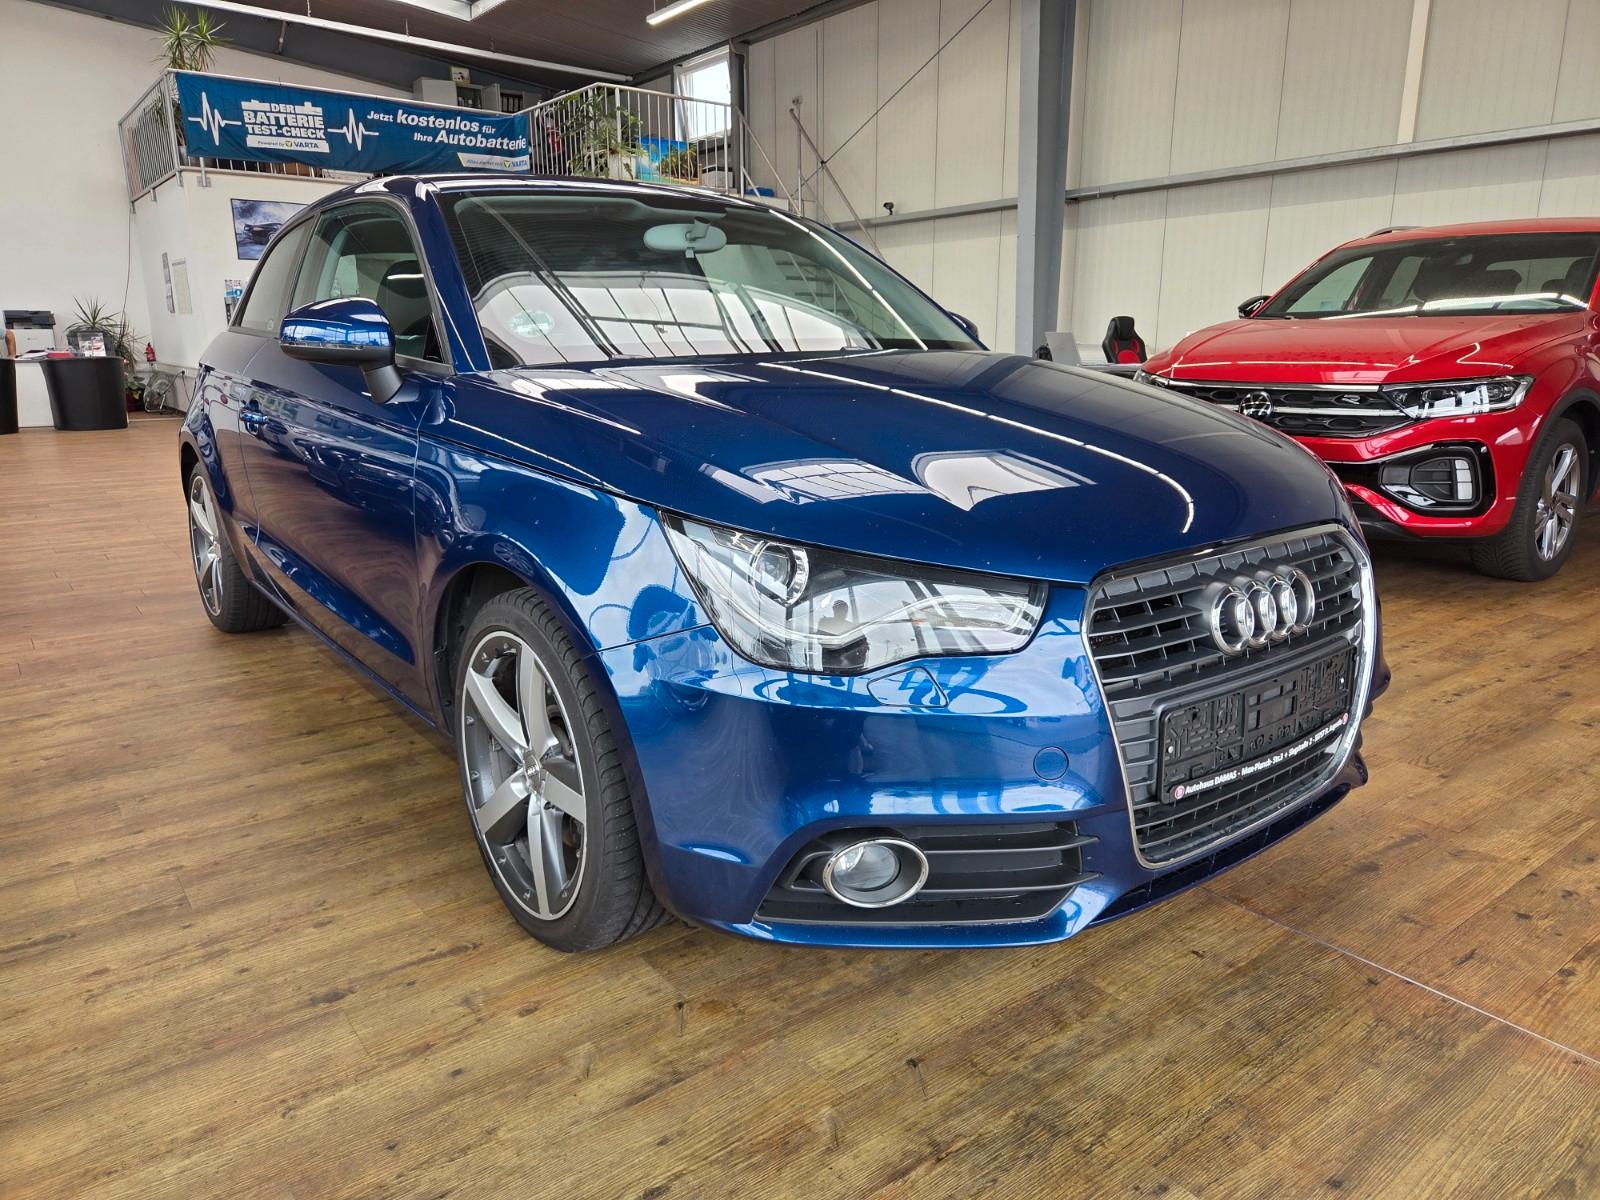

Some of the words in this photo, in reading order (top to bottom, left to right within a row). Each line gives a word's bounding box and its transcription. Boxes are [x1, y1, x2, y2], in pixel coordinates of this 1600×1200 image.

[270, 103, 295, 113] DER
[243, 111, 325, 129] BATTERIE
[367, 110, 394, 122] Jetzt
[396, 109, 480, 132] kostenlos
[482, 125, 496, 134] für
[246, 124, 326, 139] TEST-CHECK
[414, 132, 433, 143] Ihre
[435, 131, 527, 150] Autobatterie
[1185, 779, 1214, 794] Autohaus
[1214, 770, 1238, 785] DAMAS
